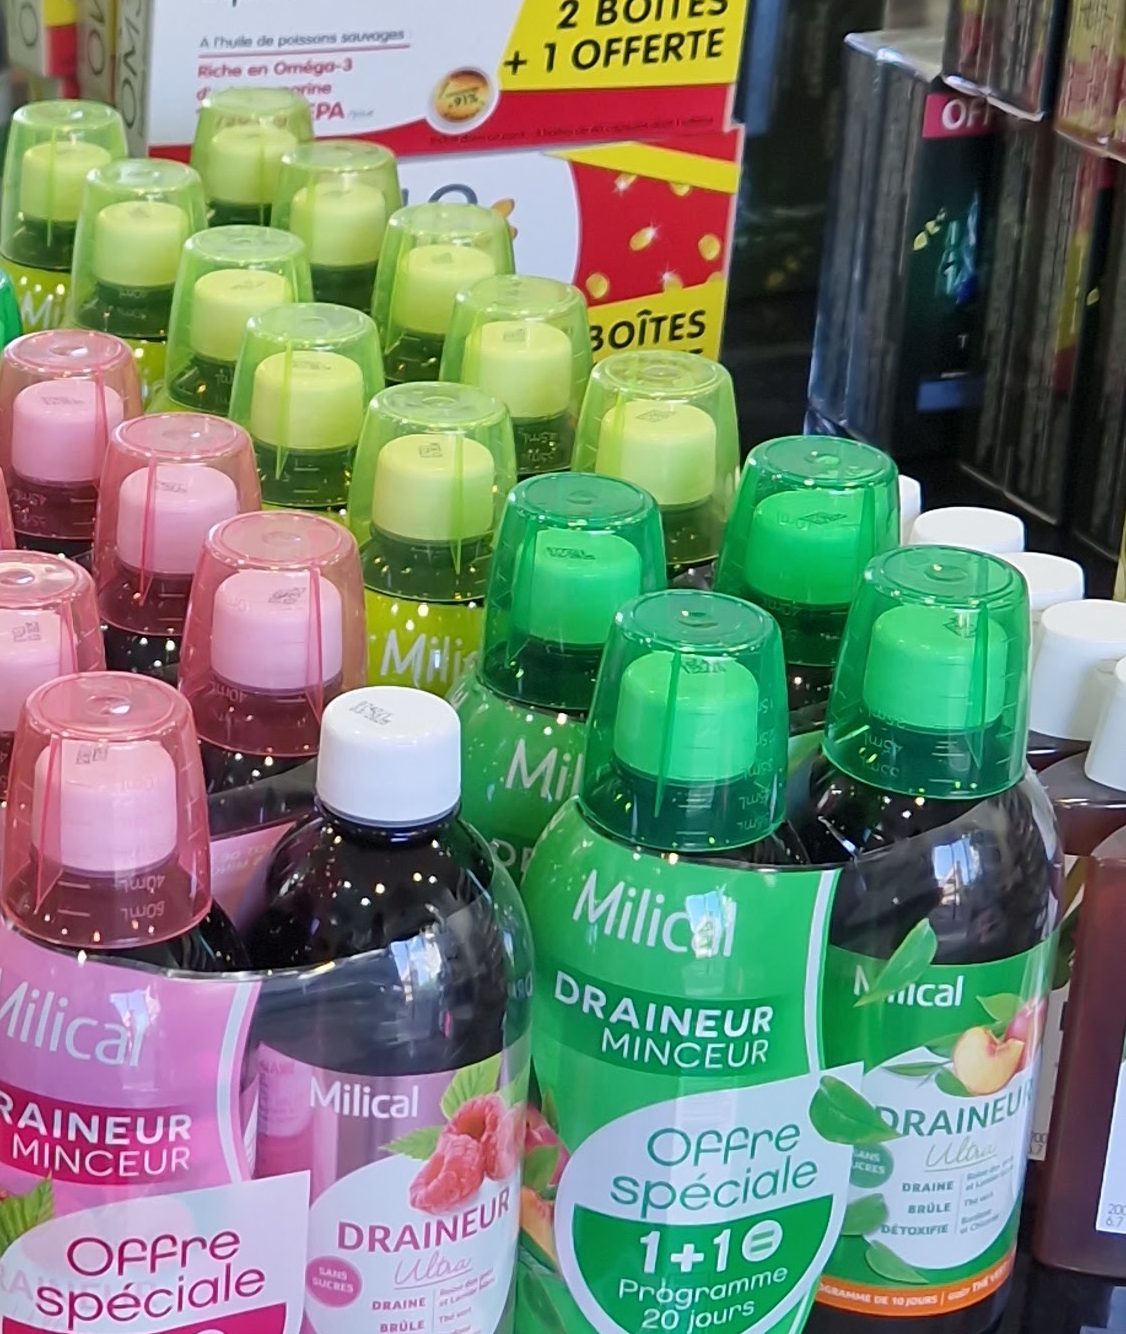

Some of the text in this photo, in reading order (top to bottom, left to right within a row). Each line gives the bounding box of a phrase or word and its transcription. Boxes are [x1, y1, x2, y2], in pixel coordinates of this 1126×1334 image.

[256, 34, 275, 48] de
[543, 40, 559, 71] 1
[570, 28, 726, 71] OFFERTE
[197, 57, 354, 79] Riche en Oméga-3
[289, 83, 333, 96] arine
[588, 308, 708, 353] BOÎTES
[572, 868, 739, 959] Milical
[553, 970, 775, 1039] DRAINEUR
[601, 1026, 770, 1070] MINCEUR
[309, 1076, 420, 1120] Milical
[12, 1132, 191, 1178] MINCEUR
[646, 1122, 802, 1167] Offre
[609, 1154, 819, 1220] spéciale
[901, 1180, 955, 1193] DRAINE
[337, 1185, 511, 1254] DRAINEUR
[880, 1222, 950, 1236] DÉTOXIFIE
[907, 1202, 952, 1215] BRÛLE
[65, 1228, 242, 1279] Offre
[318, 1266, 348, 1282] SANS
[34, 1260, 267, 1332] spéciale
[311, 1277, 355, 1295] SUCRES
[371, 1296, 427, 1311] DRAINE
[617, 1266, 789, 1310] Programme
[379, 1318, 425, 1334] BRÛLE
[641, 1299, 757, 1334] 20 jours
